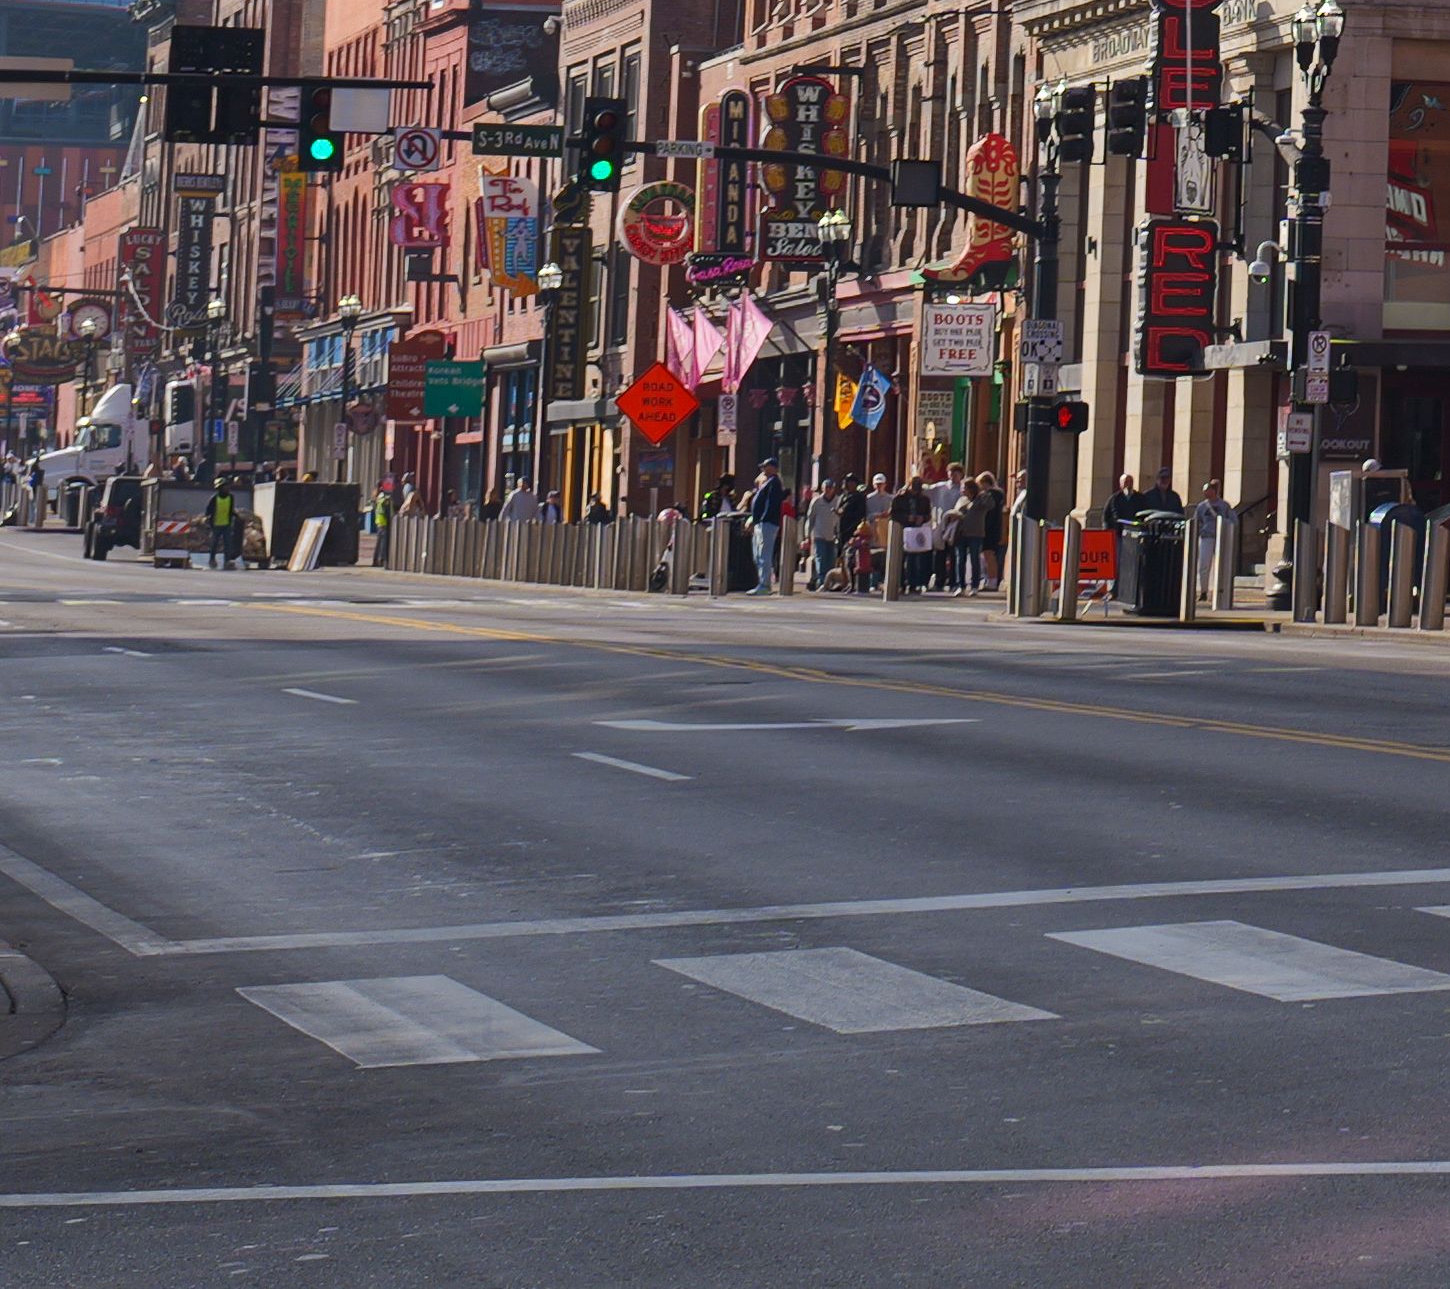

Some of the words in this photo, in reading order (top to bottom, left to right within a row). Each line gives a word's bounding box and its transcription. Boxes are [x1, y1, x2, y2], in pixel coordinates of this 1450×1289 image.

[657, 142, 704, 156] PARKING
[488, 178, 525, 195] Tin
[486, 194, 531, 217] Roof
[188, 198, 206, 305] WHISKEY
[1145, 226, 1215, 371] RED
[554, 237, 582, 398] VALENTINE
[933, 313, 985, 326] BOOTS
[933, 327, 949, 337] BUY
[933, 338, 949, 348] GET
[950, 338, 964, 347] TWO
[1022, 341, 1038, 358] OK
[938, 348, 977, 360] FREE
[642, 383, 674, 392] ROAD
[642, 397, 673, 407] WORK
[637, 413, 677, 422] AHEAD
